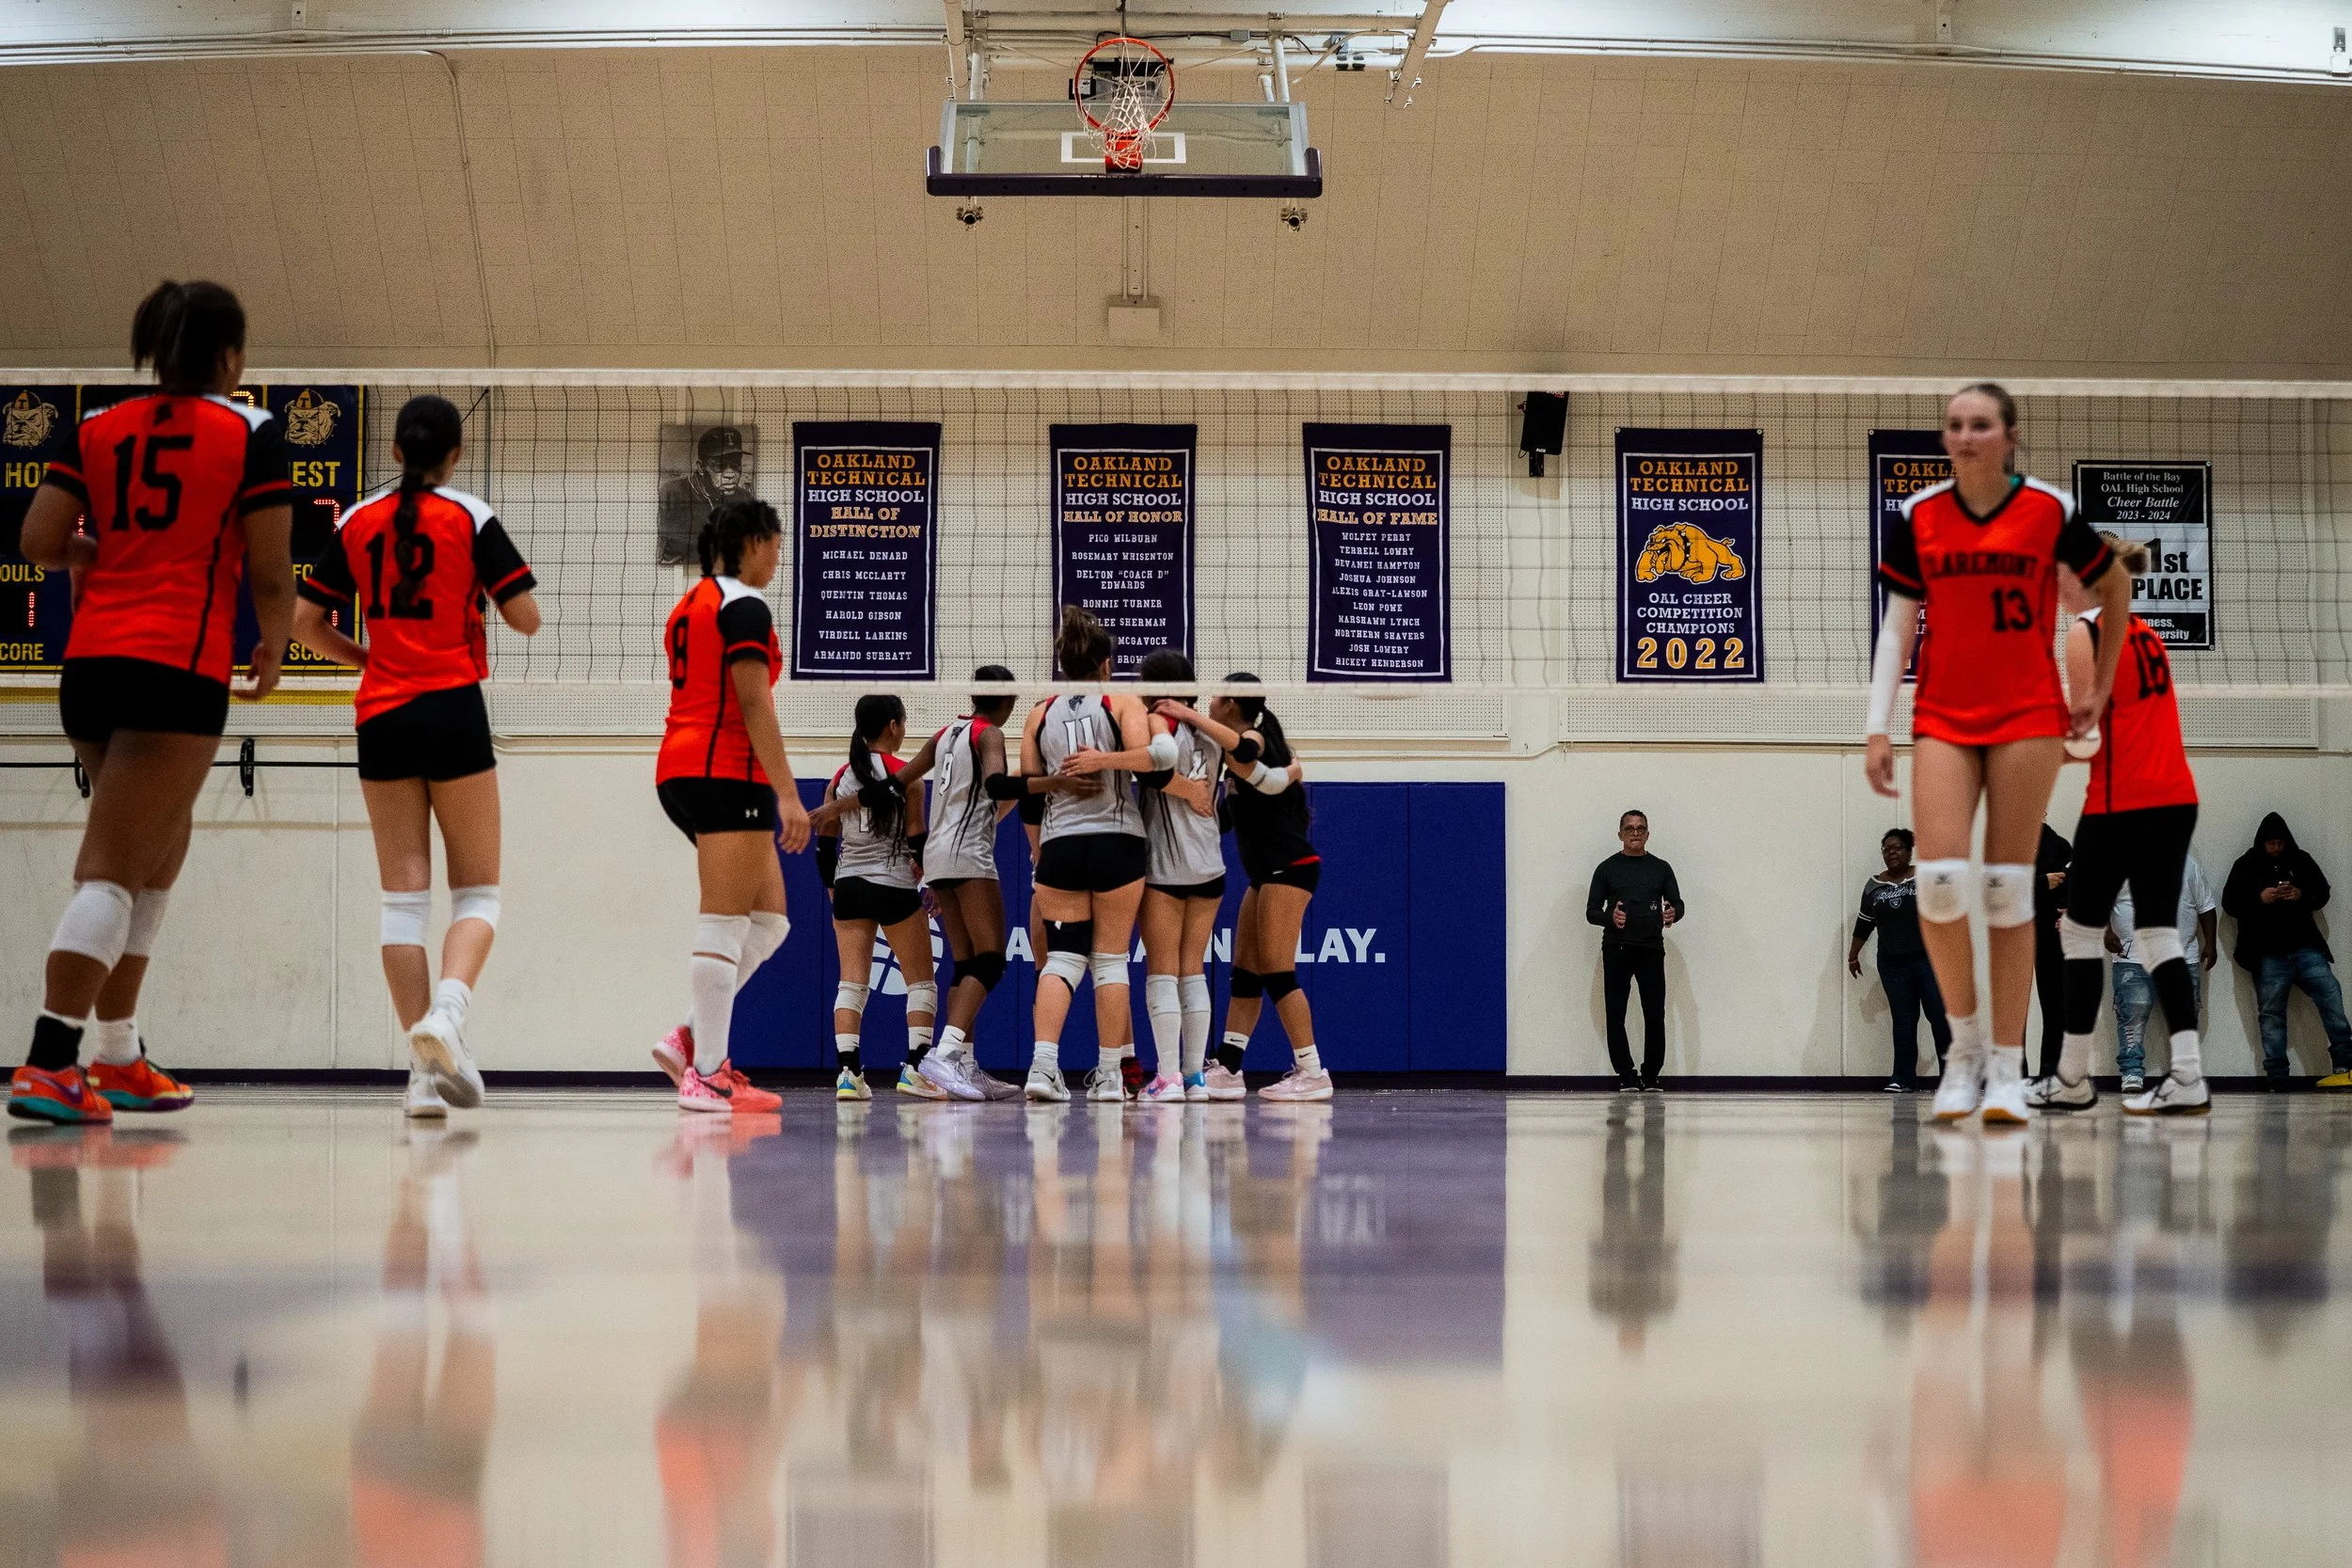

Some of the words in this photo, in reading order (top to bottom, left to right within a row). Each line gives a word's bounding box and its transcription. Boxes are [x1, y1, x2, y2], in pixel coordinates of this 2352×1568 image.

[300, 397, 309, 408] T
[723, 433, 734, 446] T
[818, 454, 915, 468] OAKLAND
[1074, 457, 1171, 470] OAKLAND
[1327, 457, 1425, 471] OAKLAND
[1640, 461, 1738, 475] OAKLAND
[1894, 463, 1958, 477] OAKLA
[6, 462, 51, 487] HO
[293, 462, 341, 487] EST
[808, 471, 925, 485] TECHNICAL
[1065, 474, 1182, 487] TECHNICAL
[1319, 473, 1436, 488] TECHNICAL
[2104, 472, 2131, 481] Battle
[2134, 472, 2144, 481] of
[2146, 472, 2160, 481] the
[2164, 473, 2181, 483] Bay
[110, 436, 194, 531] 15
[1630, 478, 1748, 492] TECHNICAL
[2101, 483, 2123, 493] OAL
[2126, 484, 2150, 495] High
[2153, 484, 2184, 493] School
[808, 490, 850, 501] HIGH
[856, 490, 924, 502] SCHOOL
[1066, 494, 1108, 505] HIGH
[1113, 494, 1181, 505] SCHOOL
[1320, 490, 1361, 504] HIGH
[1366, 493, 1435, 505] SCHOOL
[1631, 498, 1674, 510] HIGH
[1678, 499, 1748, 511] SCHOOL
[2107, 497, 2141, 508] Cheer
[2145, 497, 2179, 508] Battle
[832, 507, 873, 519] HALL
[878, 508, 899, 520] OF
[1064, 511, 1101, 522] HALL
[1105, 511, 1124, 522] OF
[1129, 511, 1183, 523] HONOR
[1317, 509, 1359, 525] HALL
[1363, 512, 1386, 524] OF
[1391, 513, 1437, 525] FAME
[2117, 510, 2138, 520] 2023
[2148, 510, 2170, 520] 2024
[810, 525, 920, 538] DISTINCTION
[1114, 534, 1157, 543] WILBURN
[1122, 552, 1173, 561] WHISENTON
[1335, 559, 1372, 568] DEVANEI
[0, 564, 45, 582] OULS
[367, 531, 434, 620] 12
[855, 571, 906, 579] MCCLARTY
[1077, 570, 1113, 578] DELTON
[1340, 573, 1371, 582] JOSHUA
[1102, 580, 1144, 589] EDWARDS
[2132, 578, 2202, 600] PLACE
[821, 591, 864, 599] QUENTIN
[869, 592, 907, 600] THOMAS
[1332, 587, 1359, 595] ALEXIS
[1083, 599, 1119, 608] RONNIE
[1123, 599, 1162, 608] TURNER
[1649, 593, 1677, 604] OAL
[1683, 594, 1732, 604] CHEER
[1354, 602, 1375, 610] LEON
[1991, 588, 2032, 632] 13
[826, 610, 863, 619] HAROLD
[868, 611, 901, 620] GIBSON
[1637, 608, 1742, 619] COMPETITION
[1120, 618, 1166, 626] SHERMAN
[1339, 615, 1385, 625] MARSHAWN
[1335, 629, 1379, 639] NORTHERN
[1646, 623, 1734, 633] CHAMPIONS
[819, 631, 860, 640] VIRDELL
[1119, 637, 1167, 645] MCGAVOCK
[0, 643, 43, 661] CORE
[673, 616, 688, 689] 8
[815, 651, 861, 659] ARMANDO
[1375, 645, 1408, 654] LOWERY
[1637, 637, 1744, 669] 2022
[1336, 657, 1366, 666] RICKEY
[1295, 927, 1386, 962] LAY.
